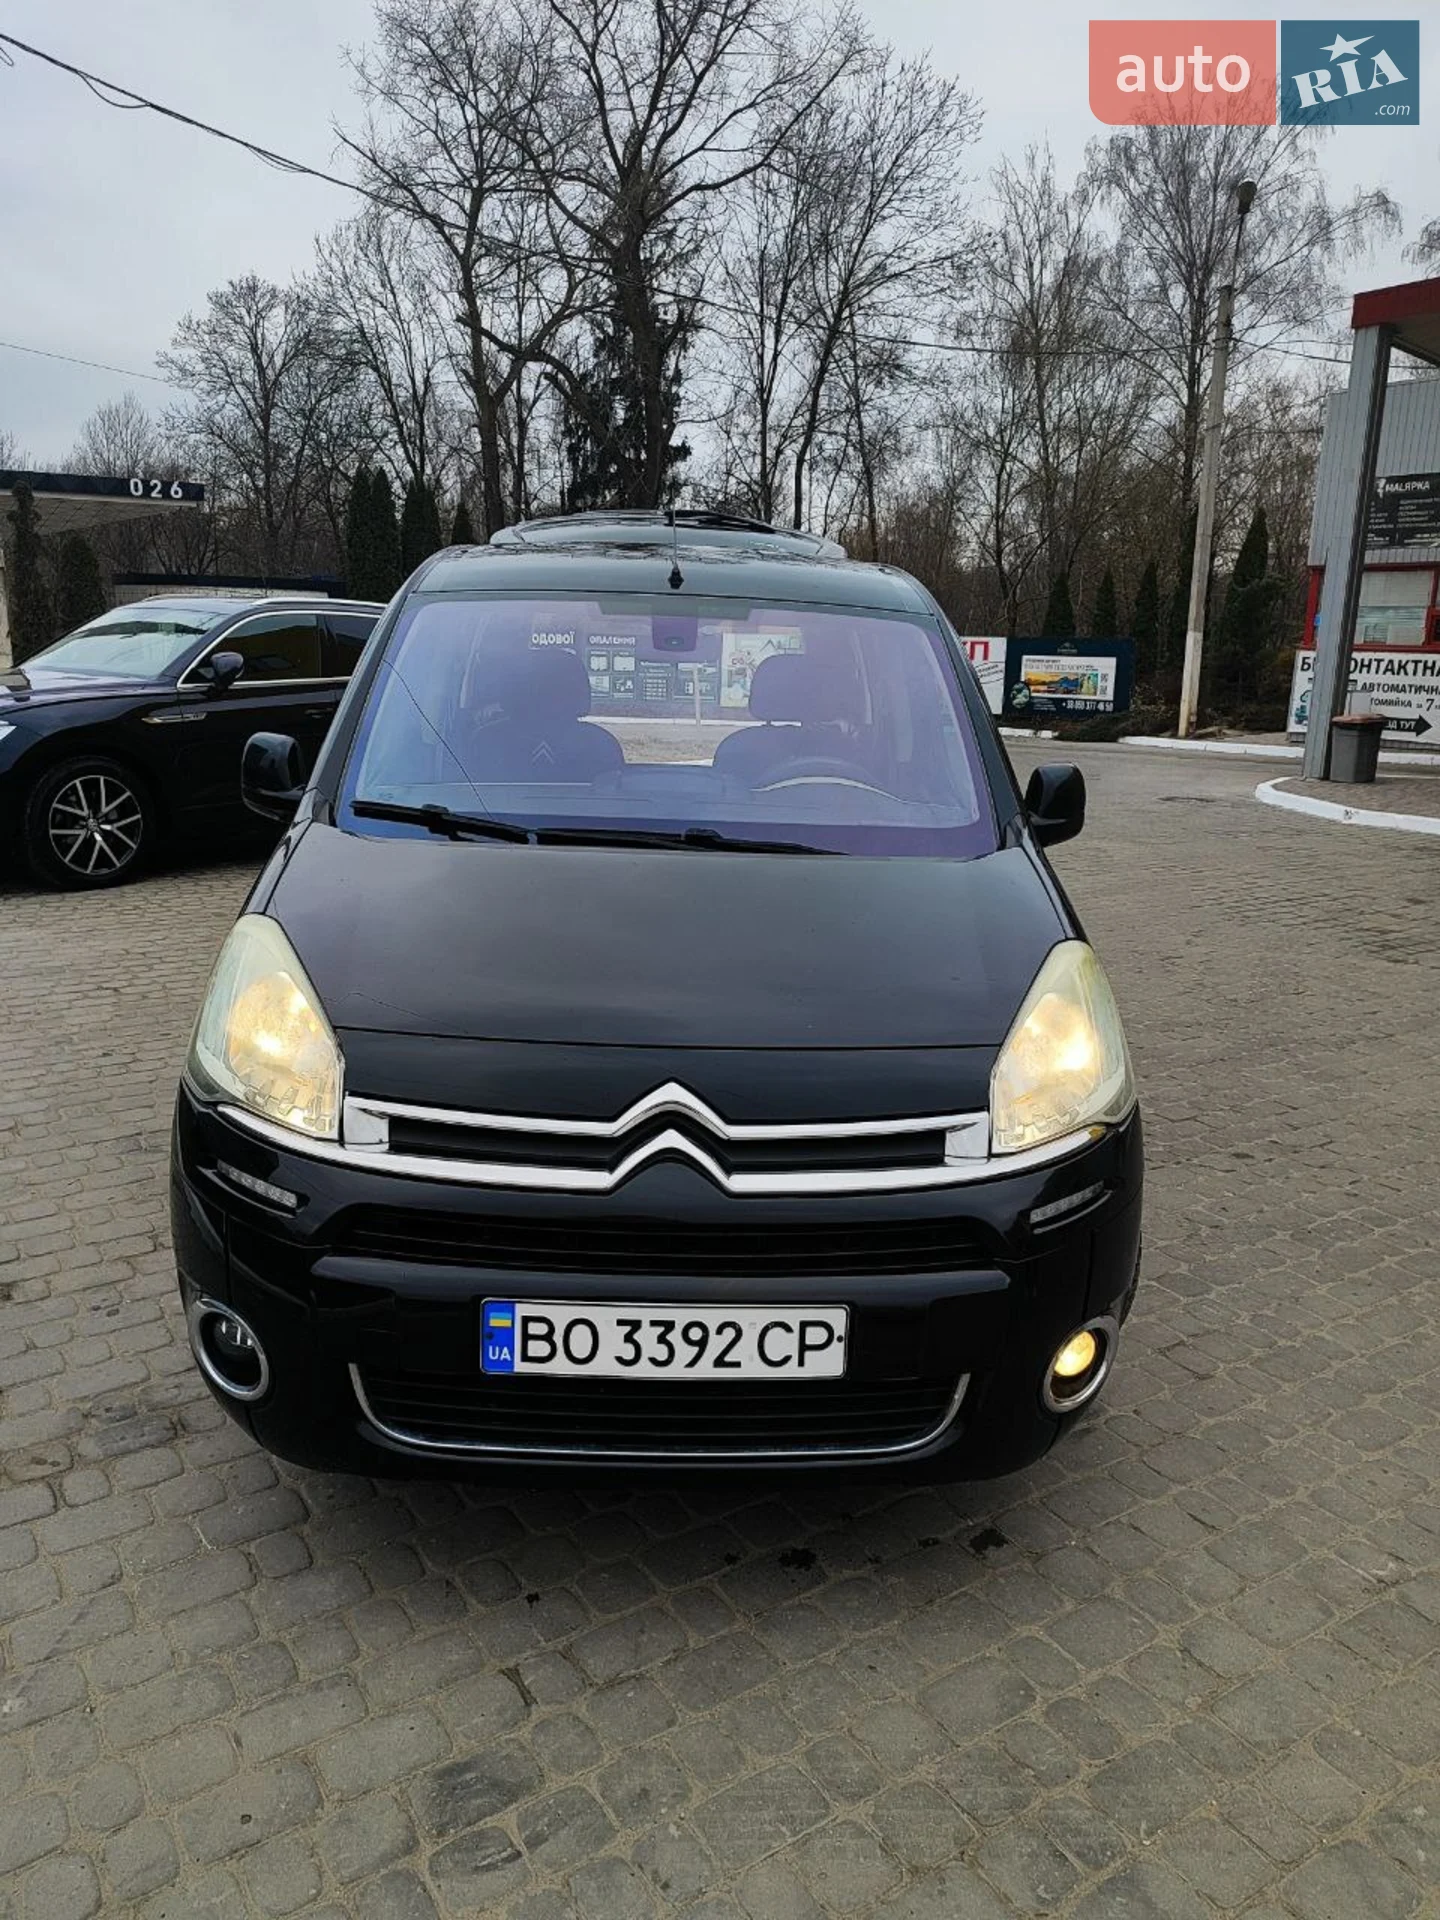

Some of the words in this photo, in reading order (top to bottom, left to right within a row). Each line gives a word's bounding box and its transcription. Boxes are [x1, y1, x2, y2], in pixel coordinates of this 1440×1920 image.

[130, 478, 183, 499] 026
[1361, 681, 1440, 696] АВТОМАТИЧН
[1425, 698, 1435, 712] 7
[1400, 721, 1416, 729] ТУТ
[520, 1315, 600, 1366] BO
[614, 1318, 743, 1368] 3392
[757, 1321, 834, 1368] CP
[488, 1346, 512, 1362] UA
